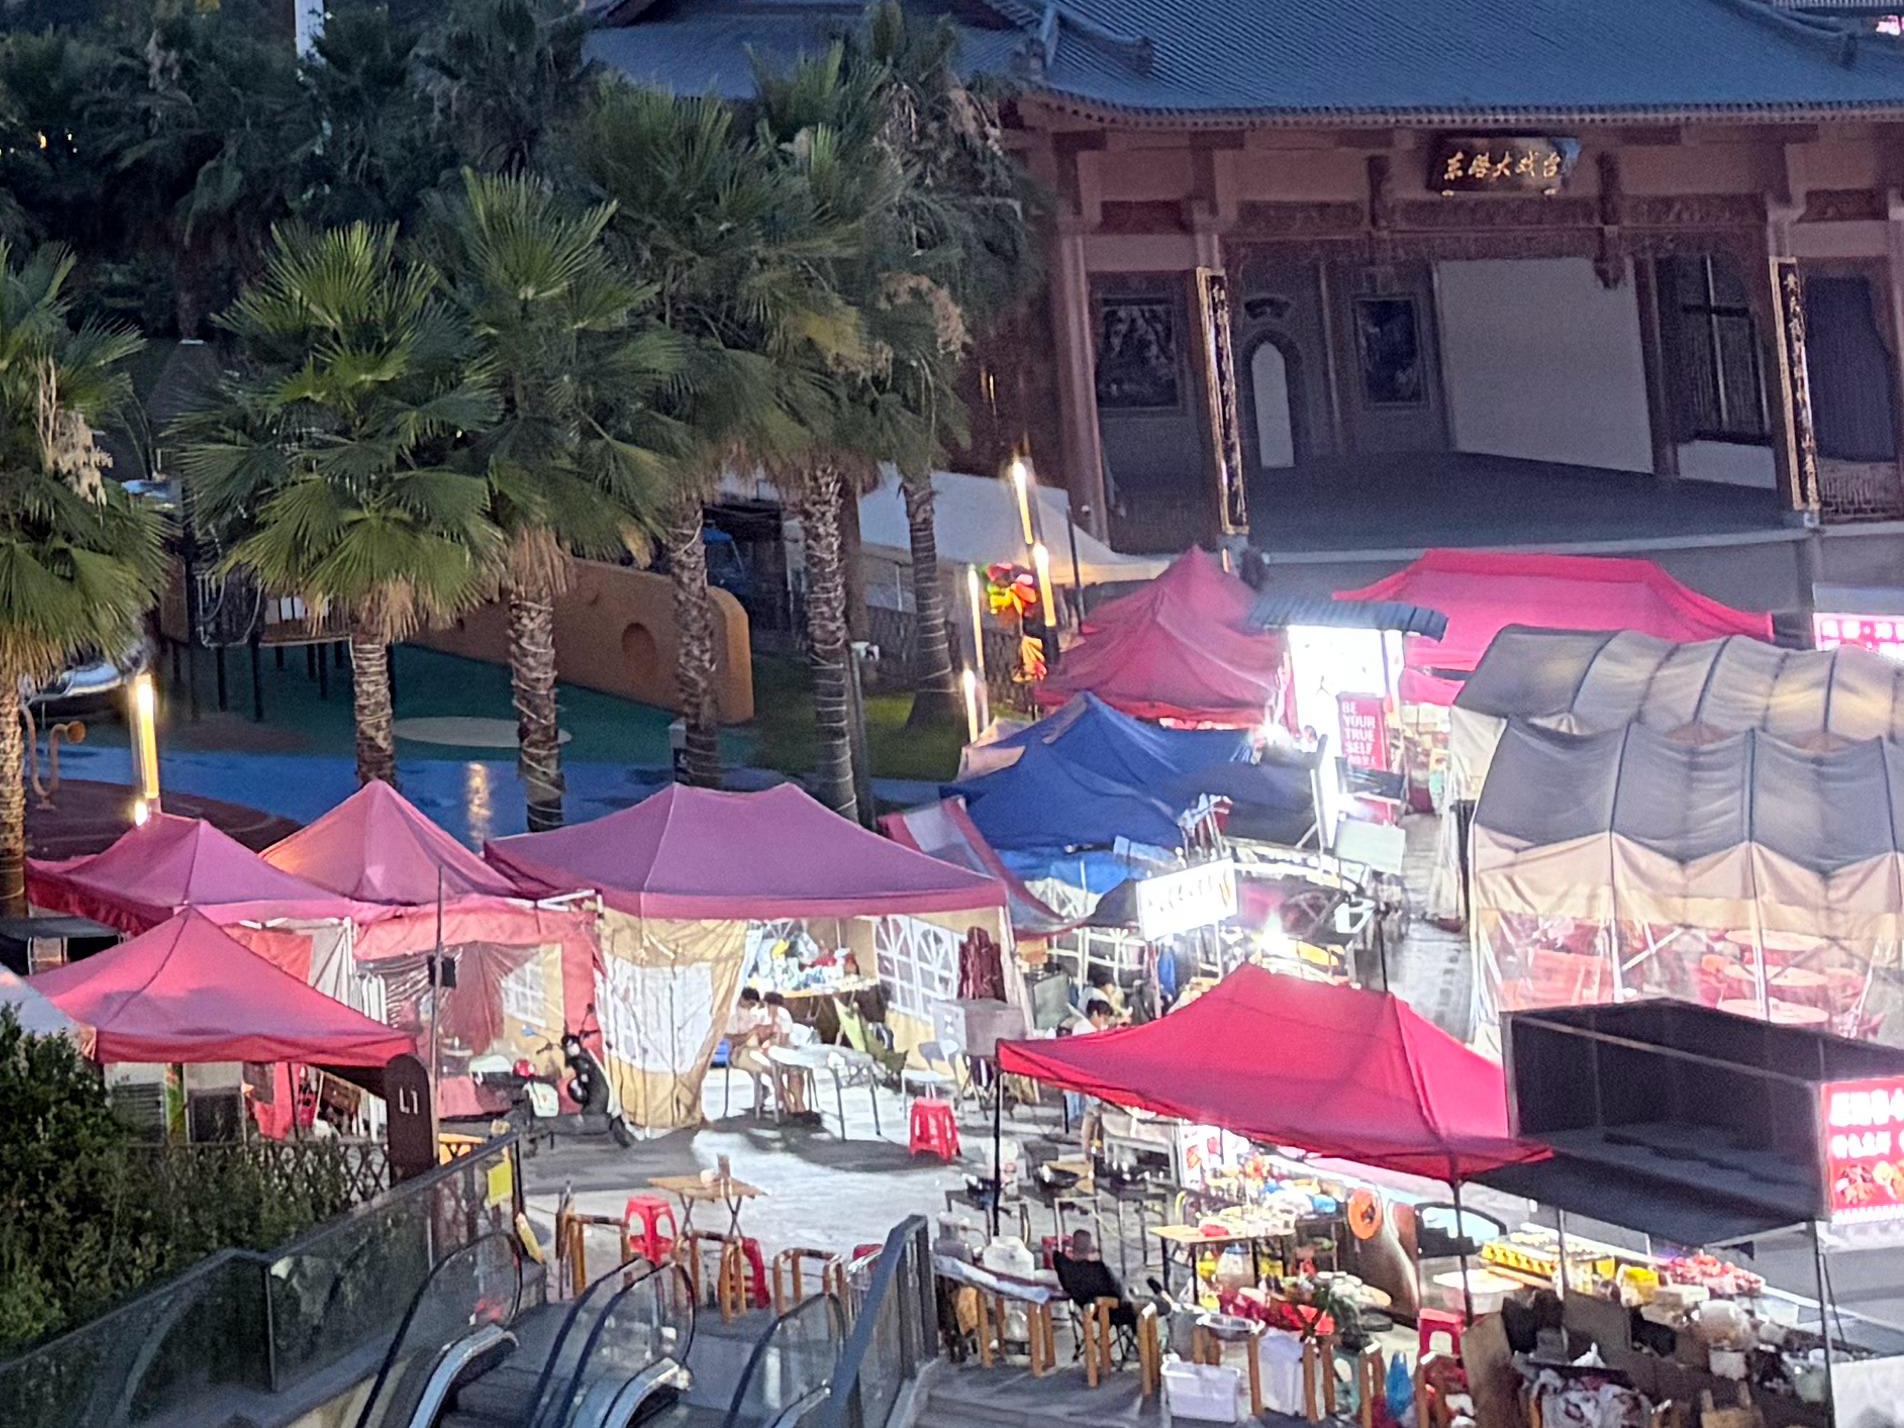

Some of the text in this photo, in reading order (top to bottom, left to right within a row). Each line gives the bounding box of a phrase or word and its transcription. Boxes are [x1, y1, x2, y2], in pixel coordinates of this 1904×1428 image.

[1342, 701, 1356, 714] BE
[1343, 715, 1375, 728] YOUR
[1345, 728, 1374, 742] TRUE
[1345, 742, 1372, 754] SELF
[399, 1087, 418, 1114] L1
